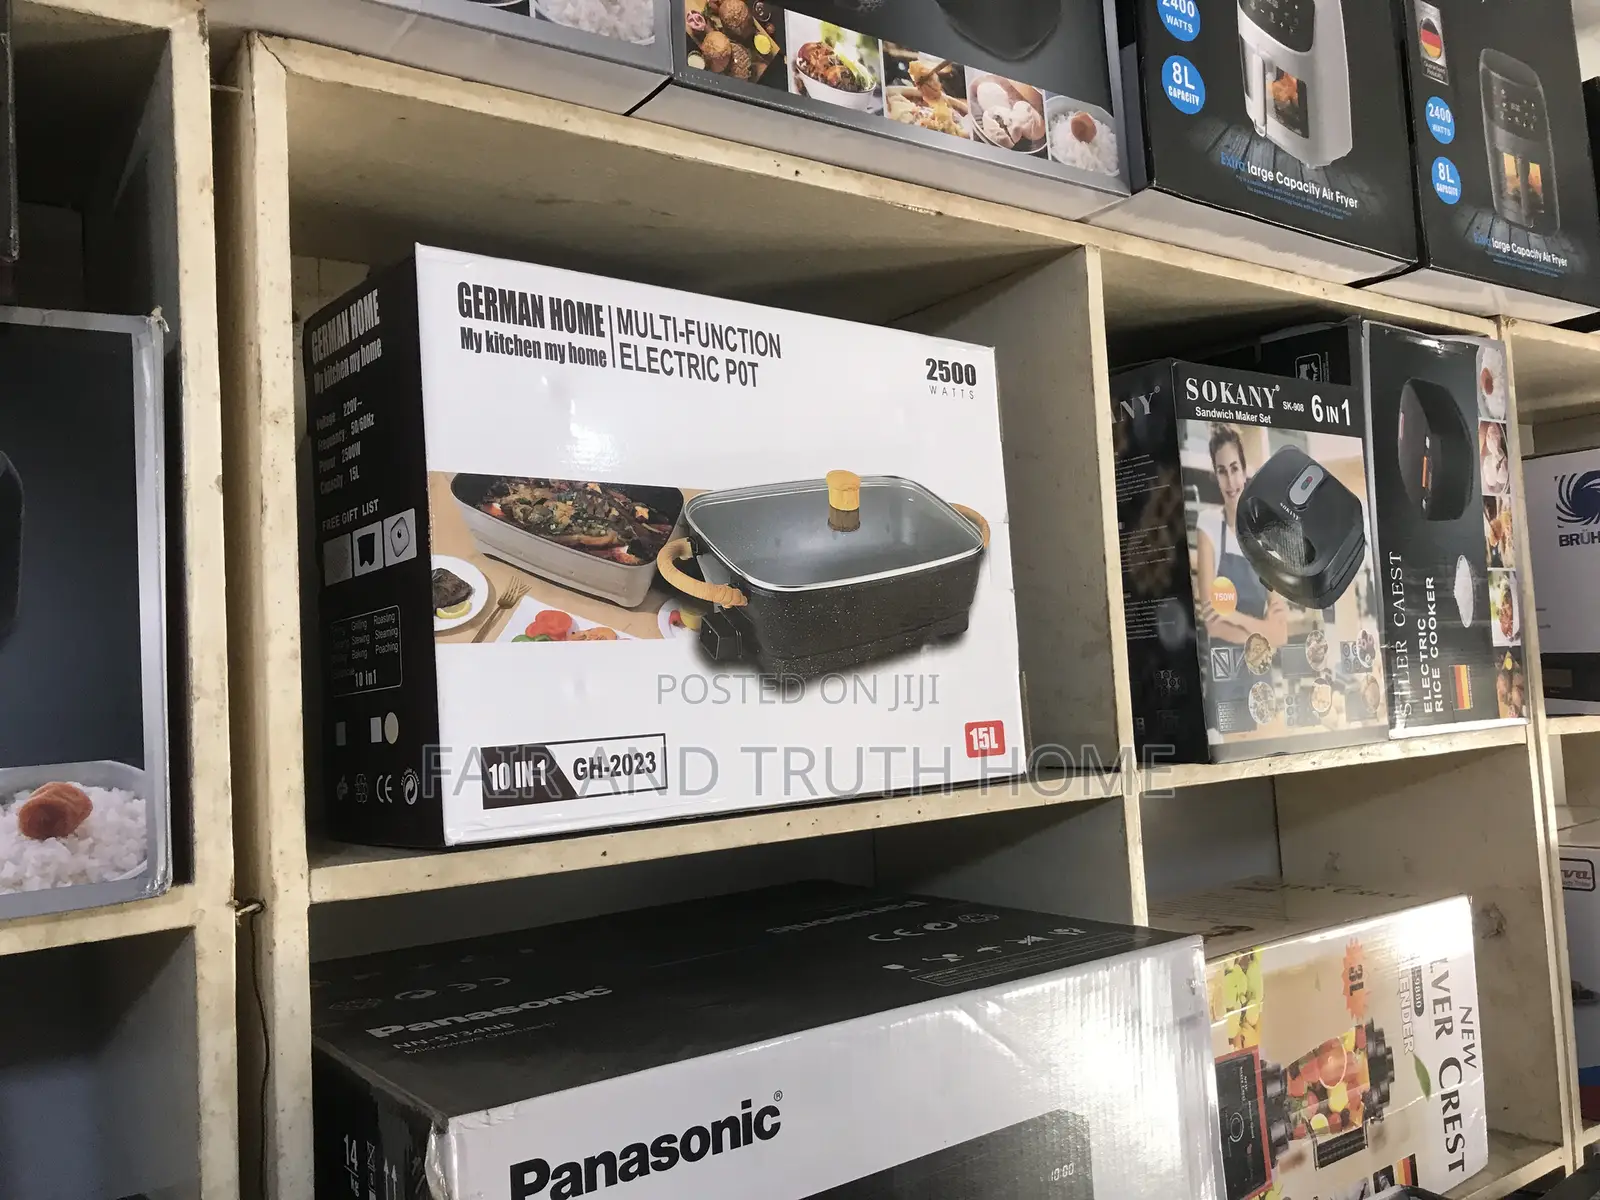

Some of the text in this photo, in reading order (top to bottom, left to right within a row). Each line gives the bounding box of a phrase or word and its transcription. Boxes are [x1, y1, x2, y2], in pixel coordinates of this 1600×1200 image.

[1166, 14, 1193, 33] WATTS
[1172, 61, 1195, 90] 8L
[1168, 86, 1200, 106] CAPACITY
[1428, 103, 1452, 123] 2400
[1220, 151, 1246, 172] Extra
[1247, 161, 1274, 182] large
[1276, 171, 1321, 199] Capacity
[1322, 186, 1335, 201] Air
[1336, 191, 1358, 209] Fryer
[1438, 162, 1455, 184] 8L
[1491, 237, 1511, 254] large
[1511, 242, 1542, 263] Capacity
[1542, 251, 1552, 263] Air
[1552, 253, 1568, 267] Fryer
[457, 281, 606, 338] GERMAN HOME
[312, 288, 380, 365] GERMAN HOME
[617, 306, 782, 359] MULTI-FUNCTION
[349, 349, 361, 374] my
[360, 338, 382, 367] home
[460, 326, 607, 368] My kitchen my home
[620, 342, 759, 387] ELECTRIC POT
[925, 357, 977, 386] 2500
[928, 384, 975, 400] WATTS
[1186, 377, 1276, 409] SOKANY
[1282, 401, 1305, 412] SK-908
[1195, 406, 1272, 424] Sandwich Maker Set
[1311, 394, 1351, 426] 6 IN 1
[349, 464, 360, 483] 15L
[322, 498, 380, 532] FREE GIFT LIST
[1214, 592, 1236, 602] 750W
[1389, 551, 1407, 627] CAEST
[1425, 576, 1444, 713] RICE COOKER
[1417, 617, 1433, 714] ELECTRIC
[969, 726, 999, 751] 15L
[488, 758, 547, 791] 10 IN 1
[572, 751, 657, 781] GH-2023
[365, 984, 613, 1038] Panasonic
[1458, 1005, 1478, 1069] NEW
[1437, 1056, 1467, 1173] CREST
[509, 1097, 782, 1200] Panasonic
